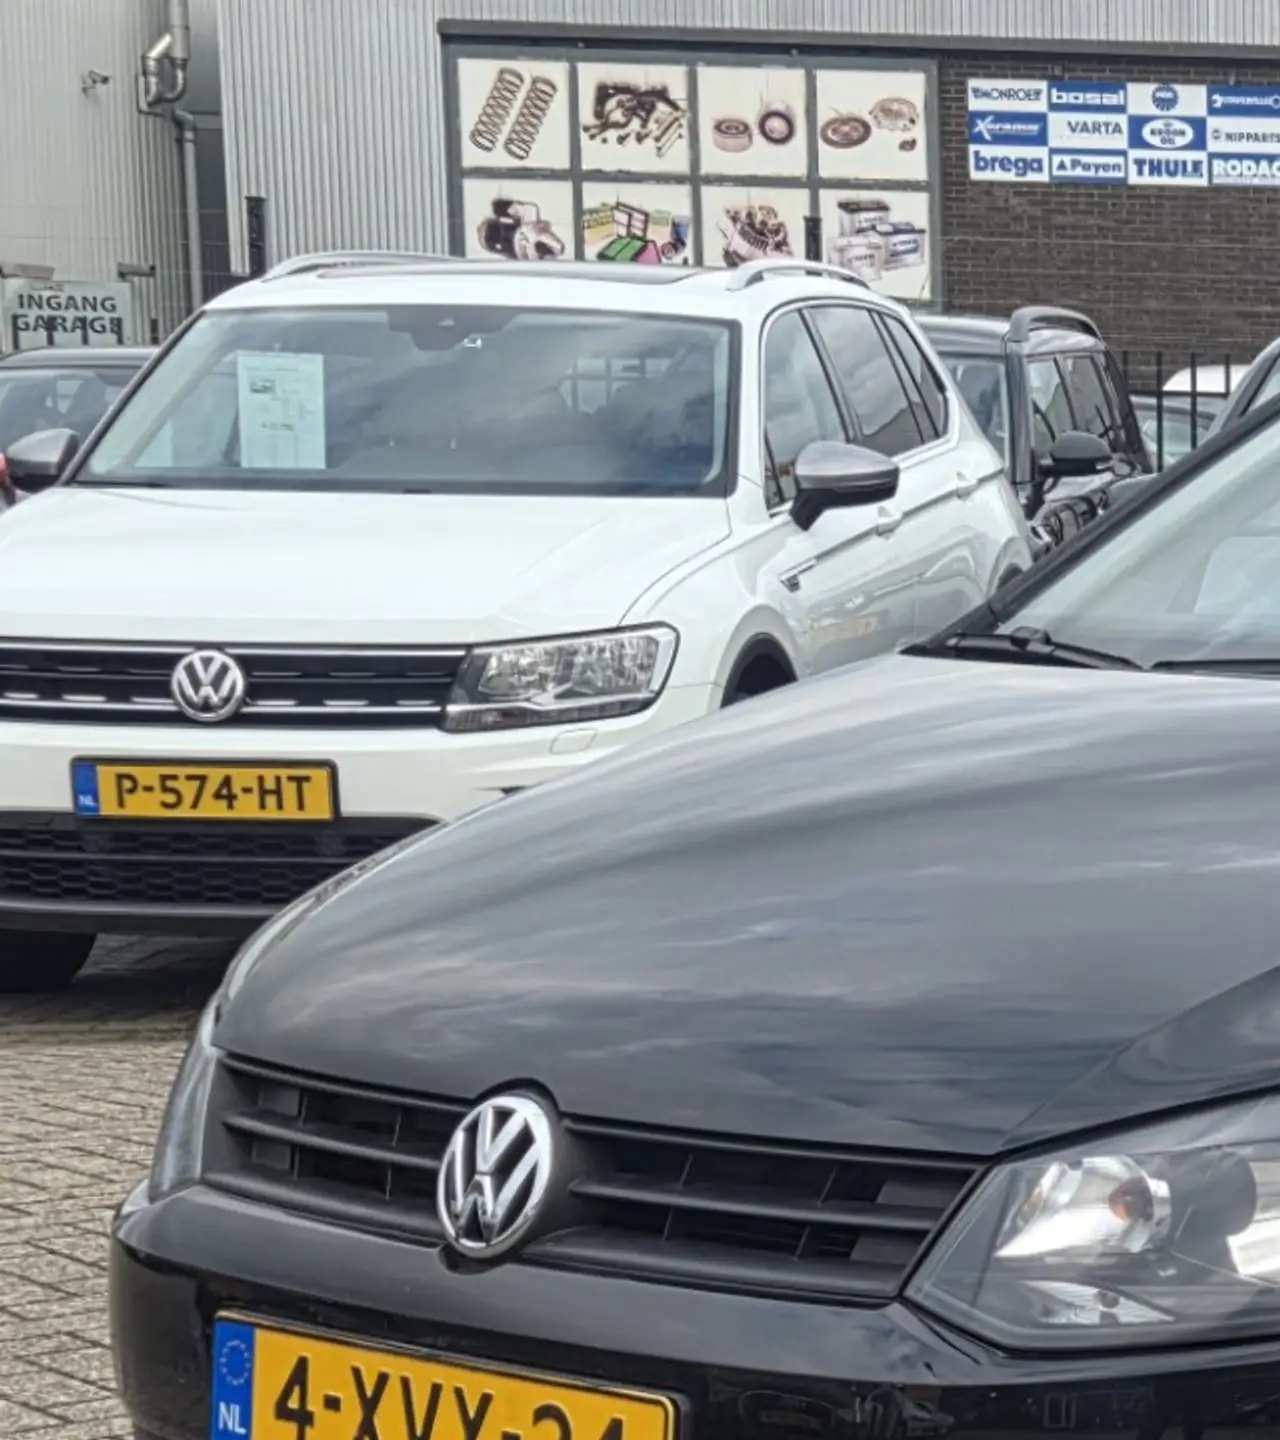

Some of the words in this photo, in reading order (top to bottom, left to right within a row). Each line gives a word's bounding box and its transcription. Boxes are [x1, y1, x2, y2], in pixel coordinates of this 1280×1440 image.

[1067, 120, 1123, 135] VARTA
[974, 150, 1044, 176] brega
[1070, 158, 1122, 176] Payen
[1133, 158, 1204, 178] THULE
[18, 293, 117, 313] INGANG
[13, 313, 122, 335] GARAGE
[115, 773, 311, 811] P-574-HT
[218, 1401, 247, 1434] NL
